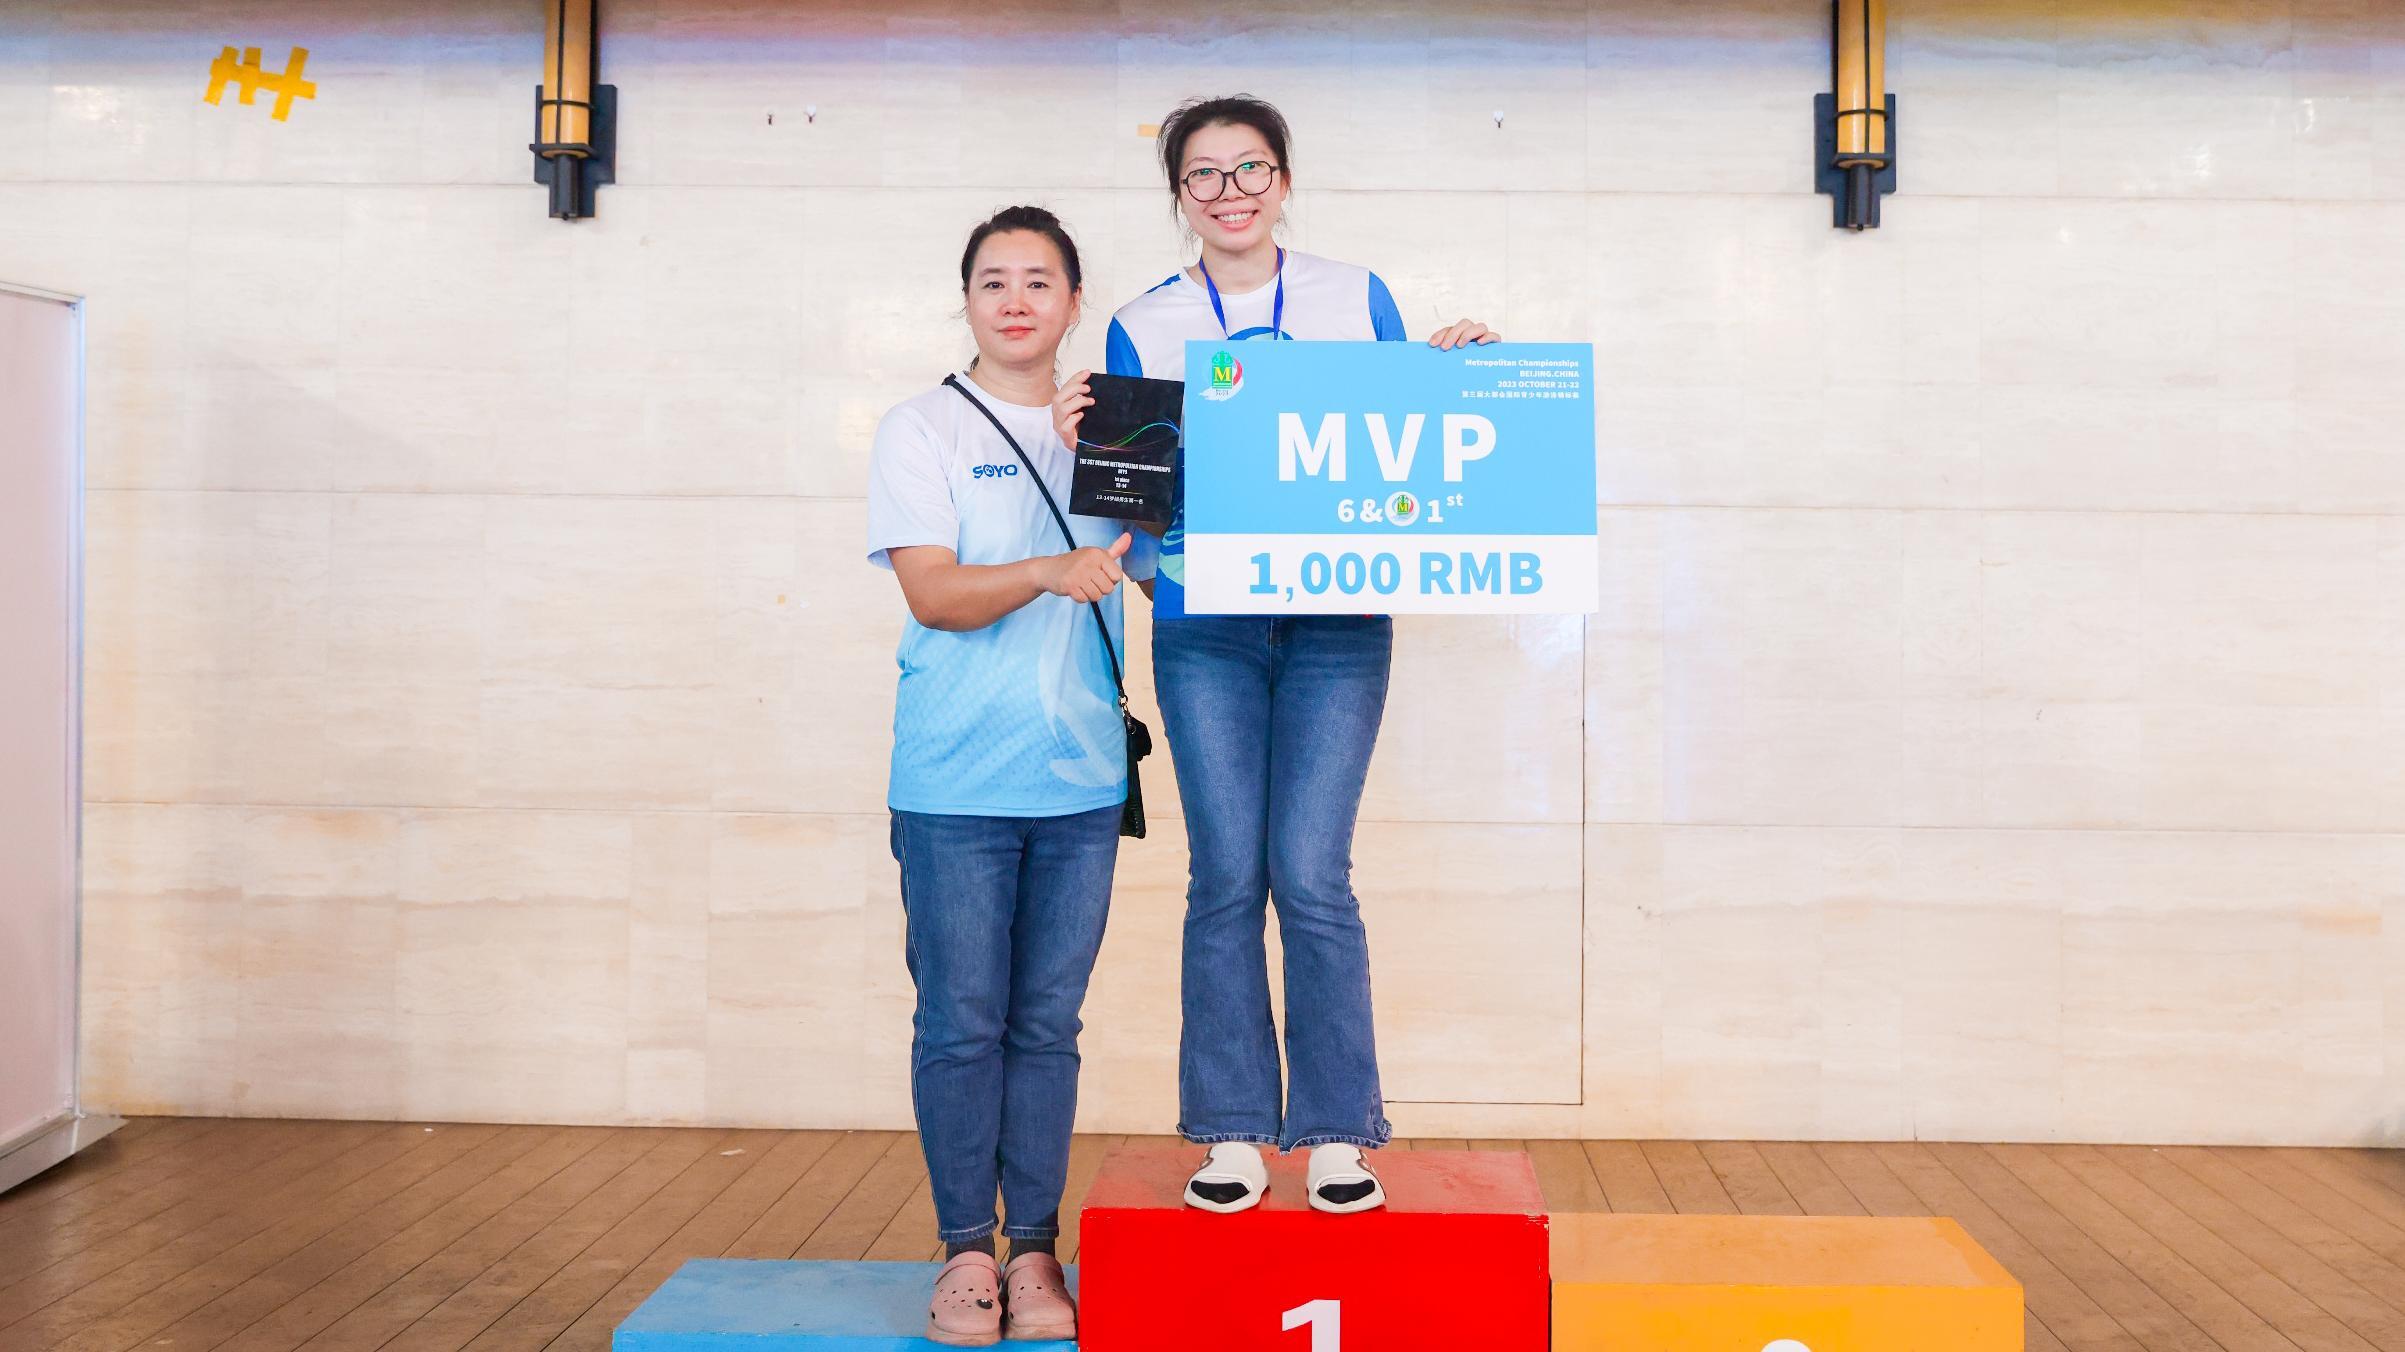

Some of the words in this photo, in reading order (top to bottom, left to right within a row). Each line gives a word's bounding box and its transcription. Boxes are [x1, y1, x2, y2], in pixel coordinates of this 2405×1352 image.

[1214, 366, 1231, 382] M
[1465, 359, 1516, 368] Metropolitan
[1518, 359, 1579, 368] Championships
[1278, 412, 1497, 482] MVP
[972, 464, 1018, 479] SOYO
[1249, 551, 1401, 602] 1,000
[1419, 551, 1543, 596] RMB
[1282, 1299, 1341, 1352] 1
